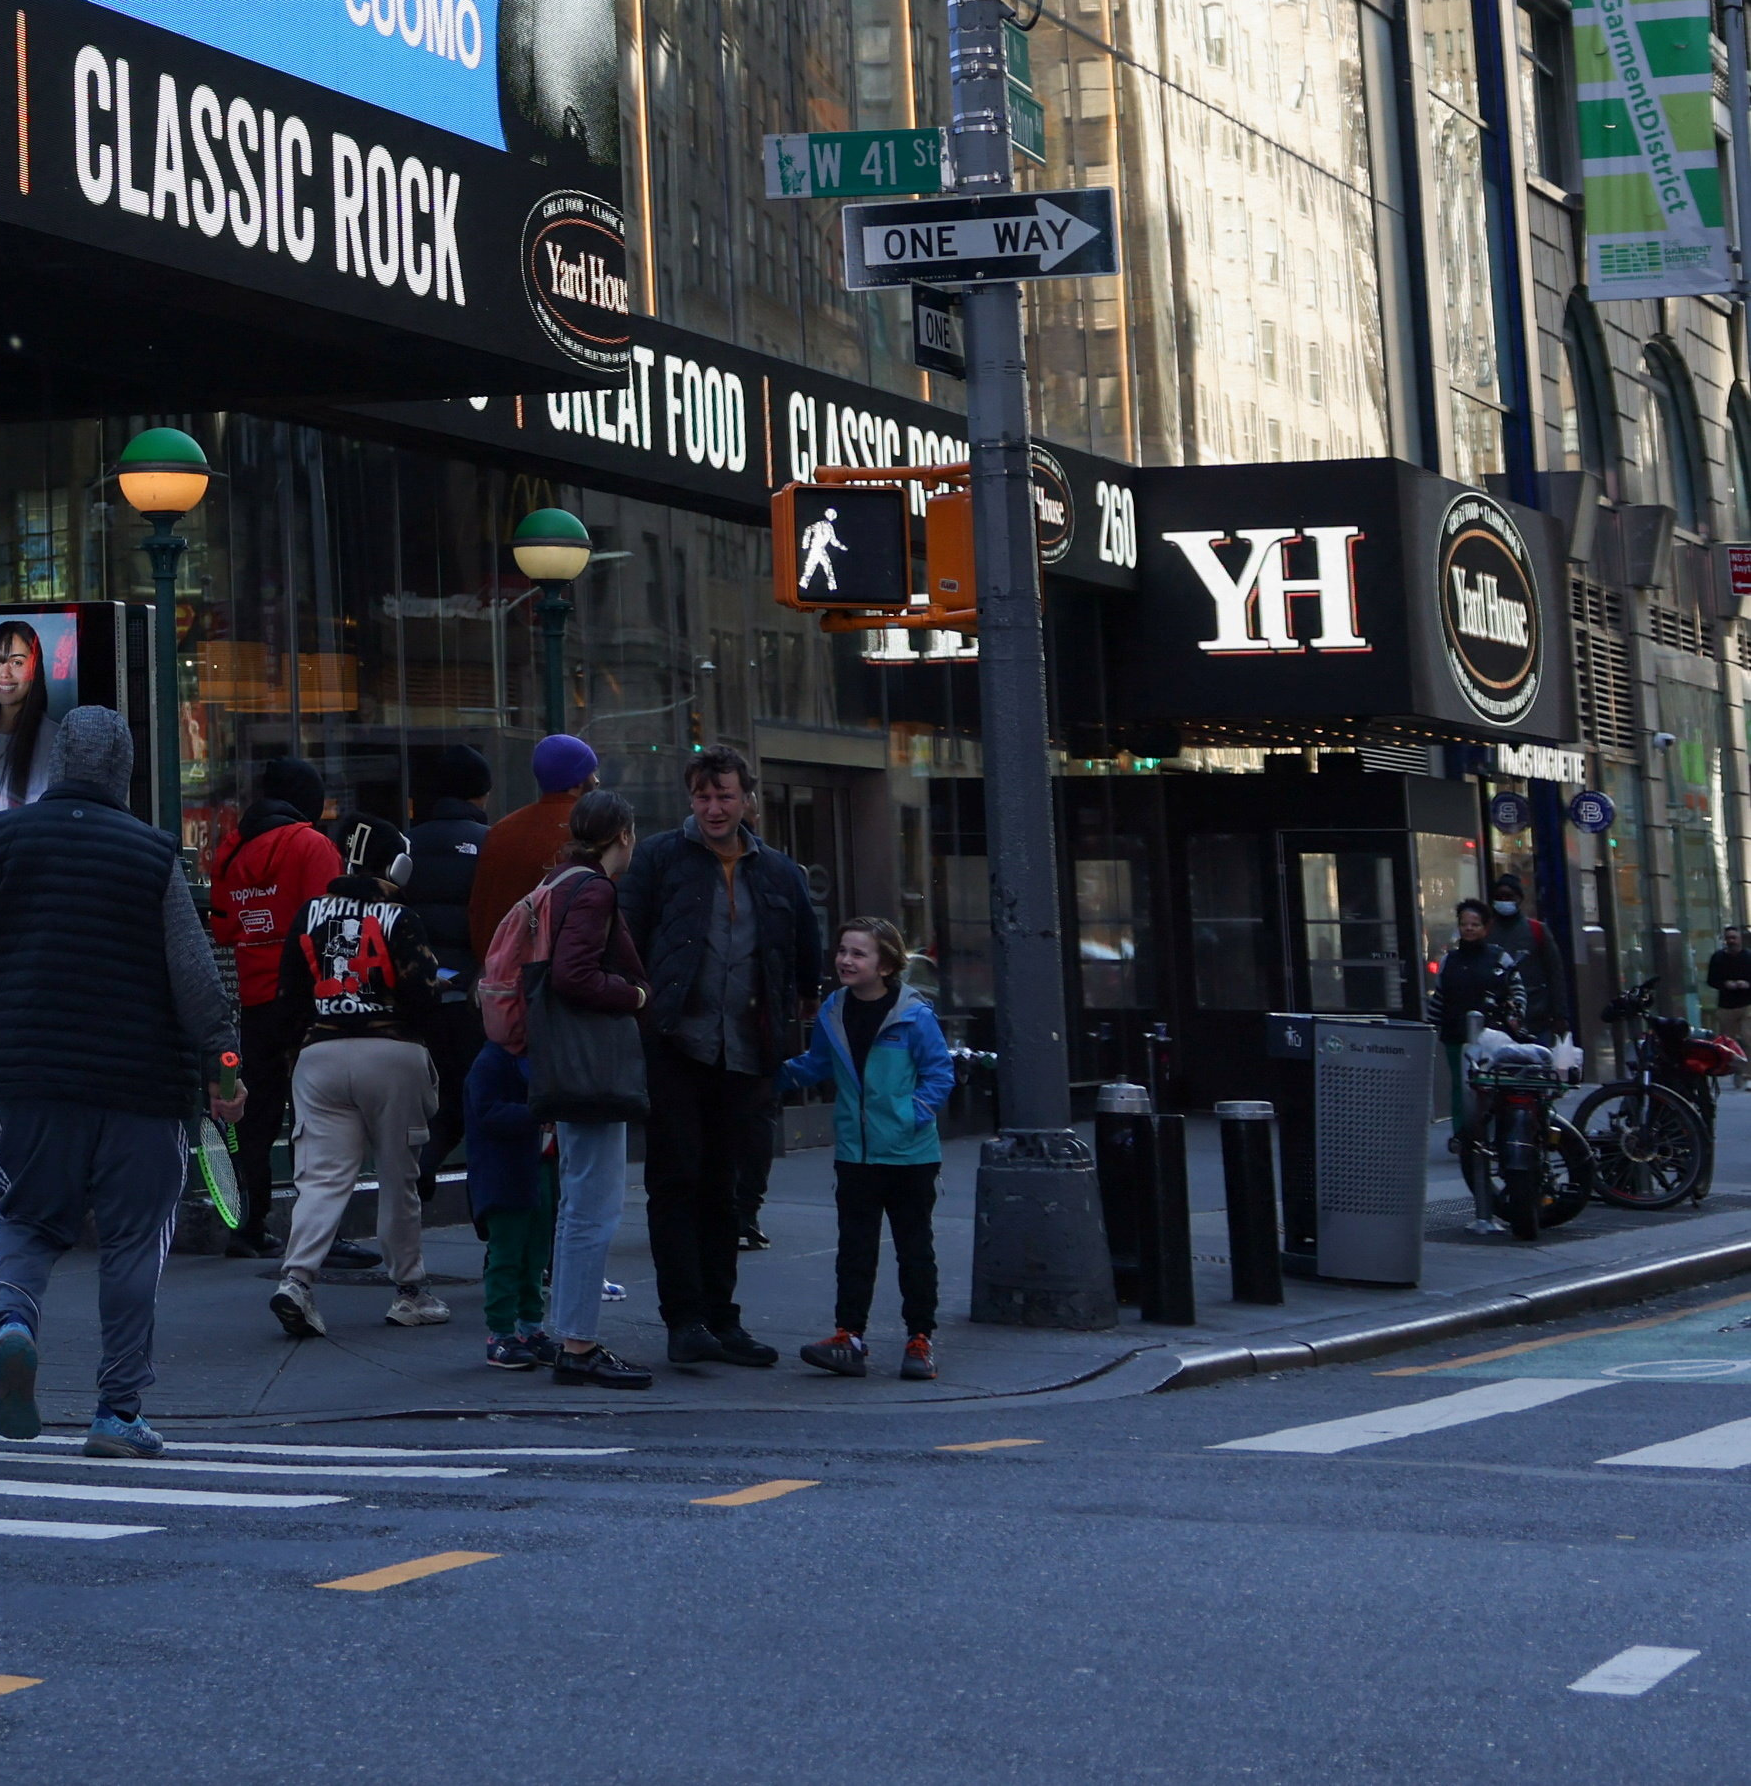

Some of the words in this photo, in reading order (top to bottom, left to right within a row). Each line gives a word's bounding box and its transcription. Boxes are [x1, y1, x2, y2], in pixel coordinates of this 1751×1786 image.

[73, 44, 315, 264] CLASSIC
[331, 132, 467, 307] ROCK
[812, 142, 842, 189] W
[859, 140, 898, 187] 41
[912, 137, 937, 167] St
[544, 239, 589, 304] Yard
[588, 252, 630, 316] Hou
[883, 224, 959, 261] ONE
[993, 217, 1072, 254] WAY
[924, 314, 952, 351] ONE
[663, 354, 748, 474] FOOD
[1095, 479, 1138, 571] 260
[1160, 525, 1373, 655] YH
[1450, 564, 1487, 638] Yard
[1483, 572, 1530, 650] House
[306, 895, 361, 936] DEATH
[362, 901, 403, 942] ROW
